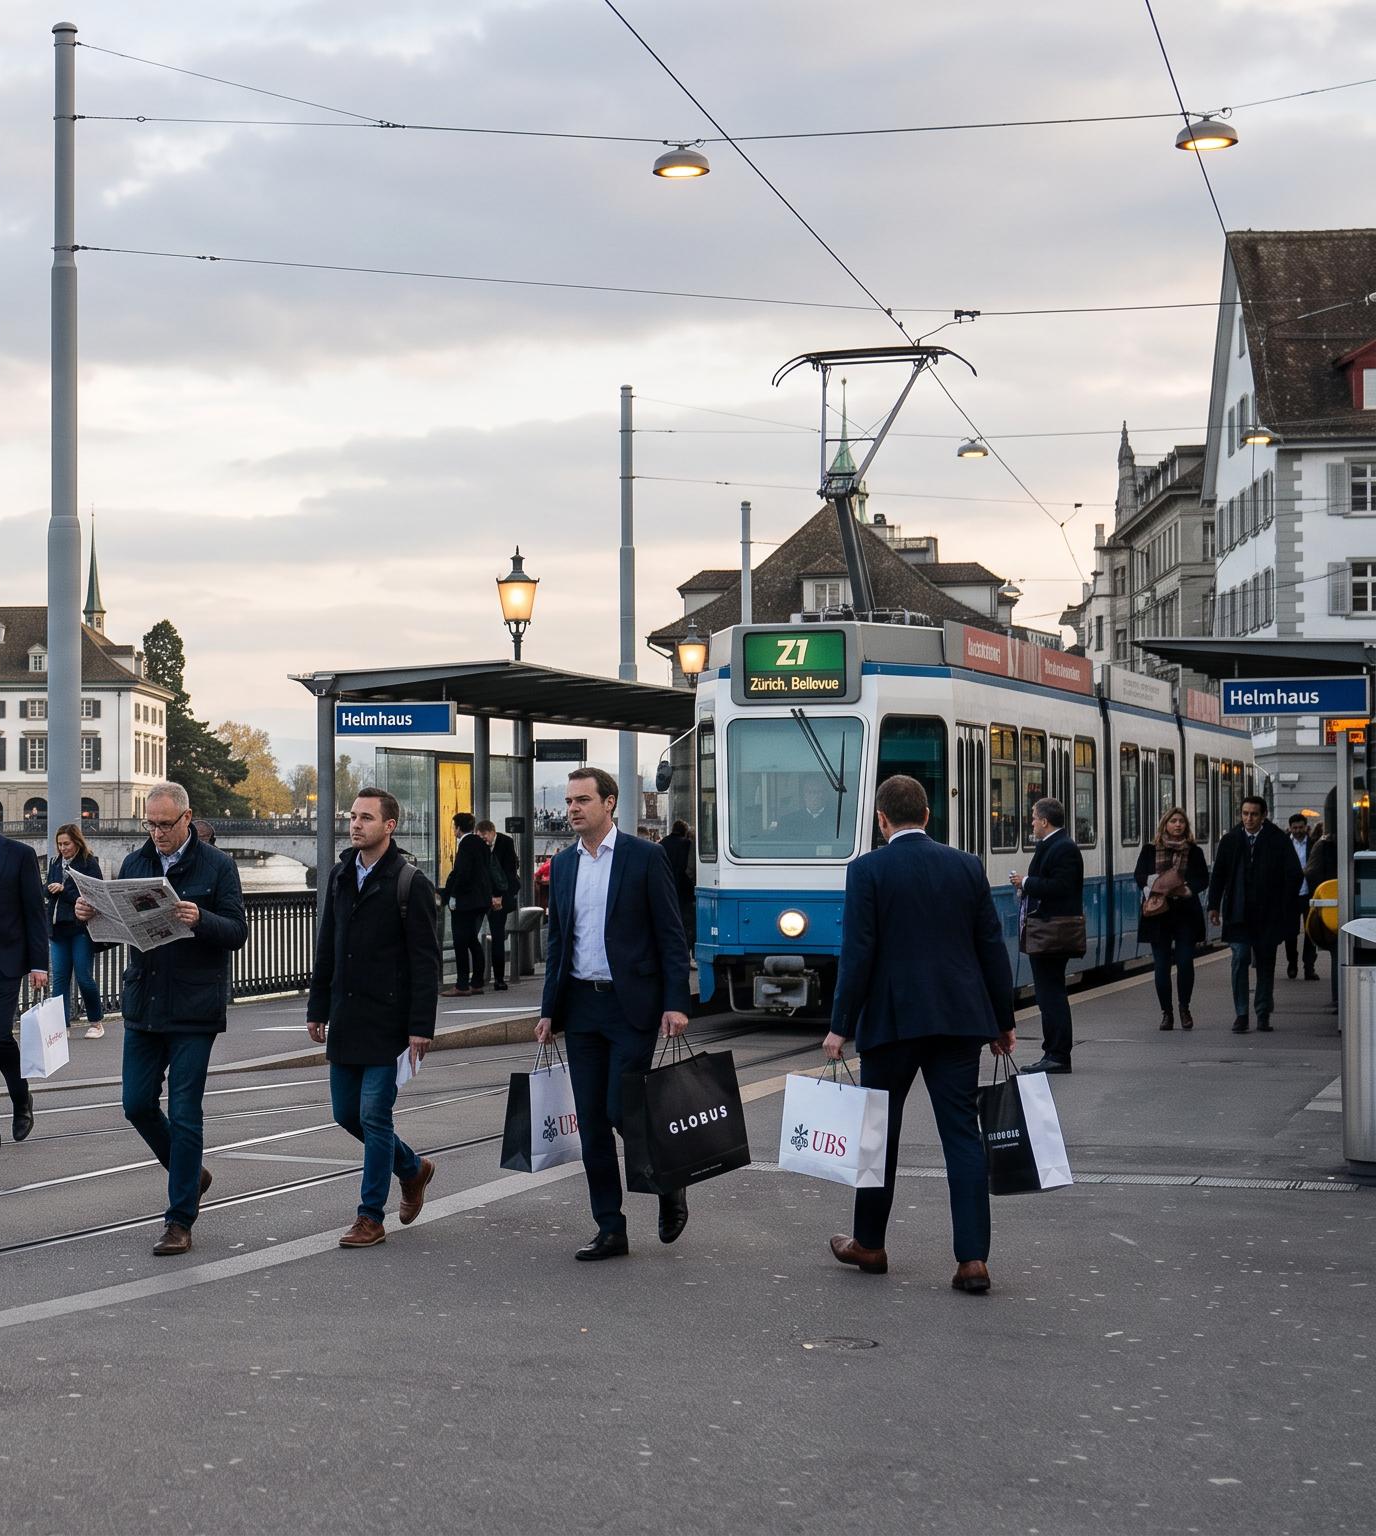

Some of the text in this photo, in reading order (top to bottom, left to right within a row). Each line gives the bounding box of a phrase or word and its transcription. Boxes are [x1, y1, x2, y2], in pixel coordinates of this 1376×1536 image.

[750, 677, 788, 691] Zürich,
[1230, 688, 1320, 706] Helmhaus
[342, 711, 413, 726] Helmhaus
[669, 1105, 728, 1134] GLOBUS
[812, 1130, 847, 1157] UBS
